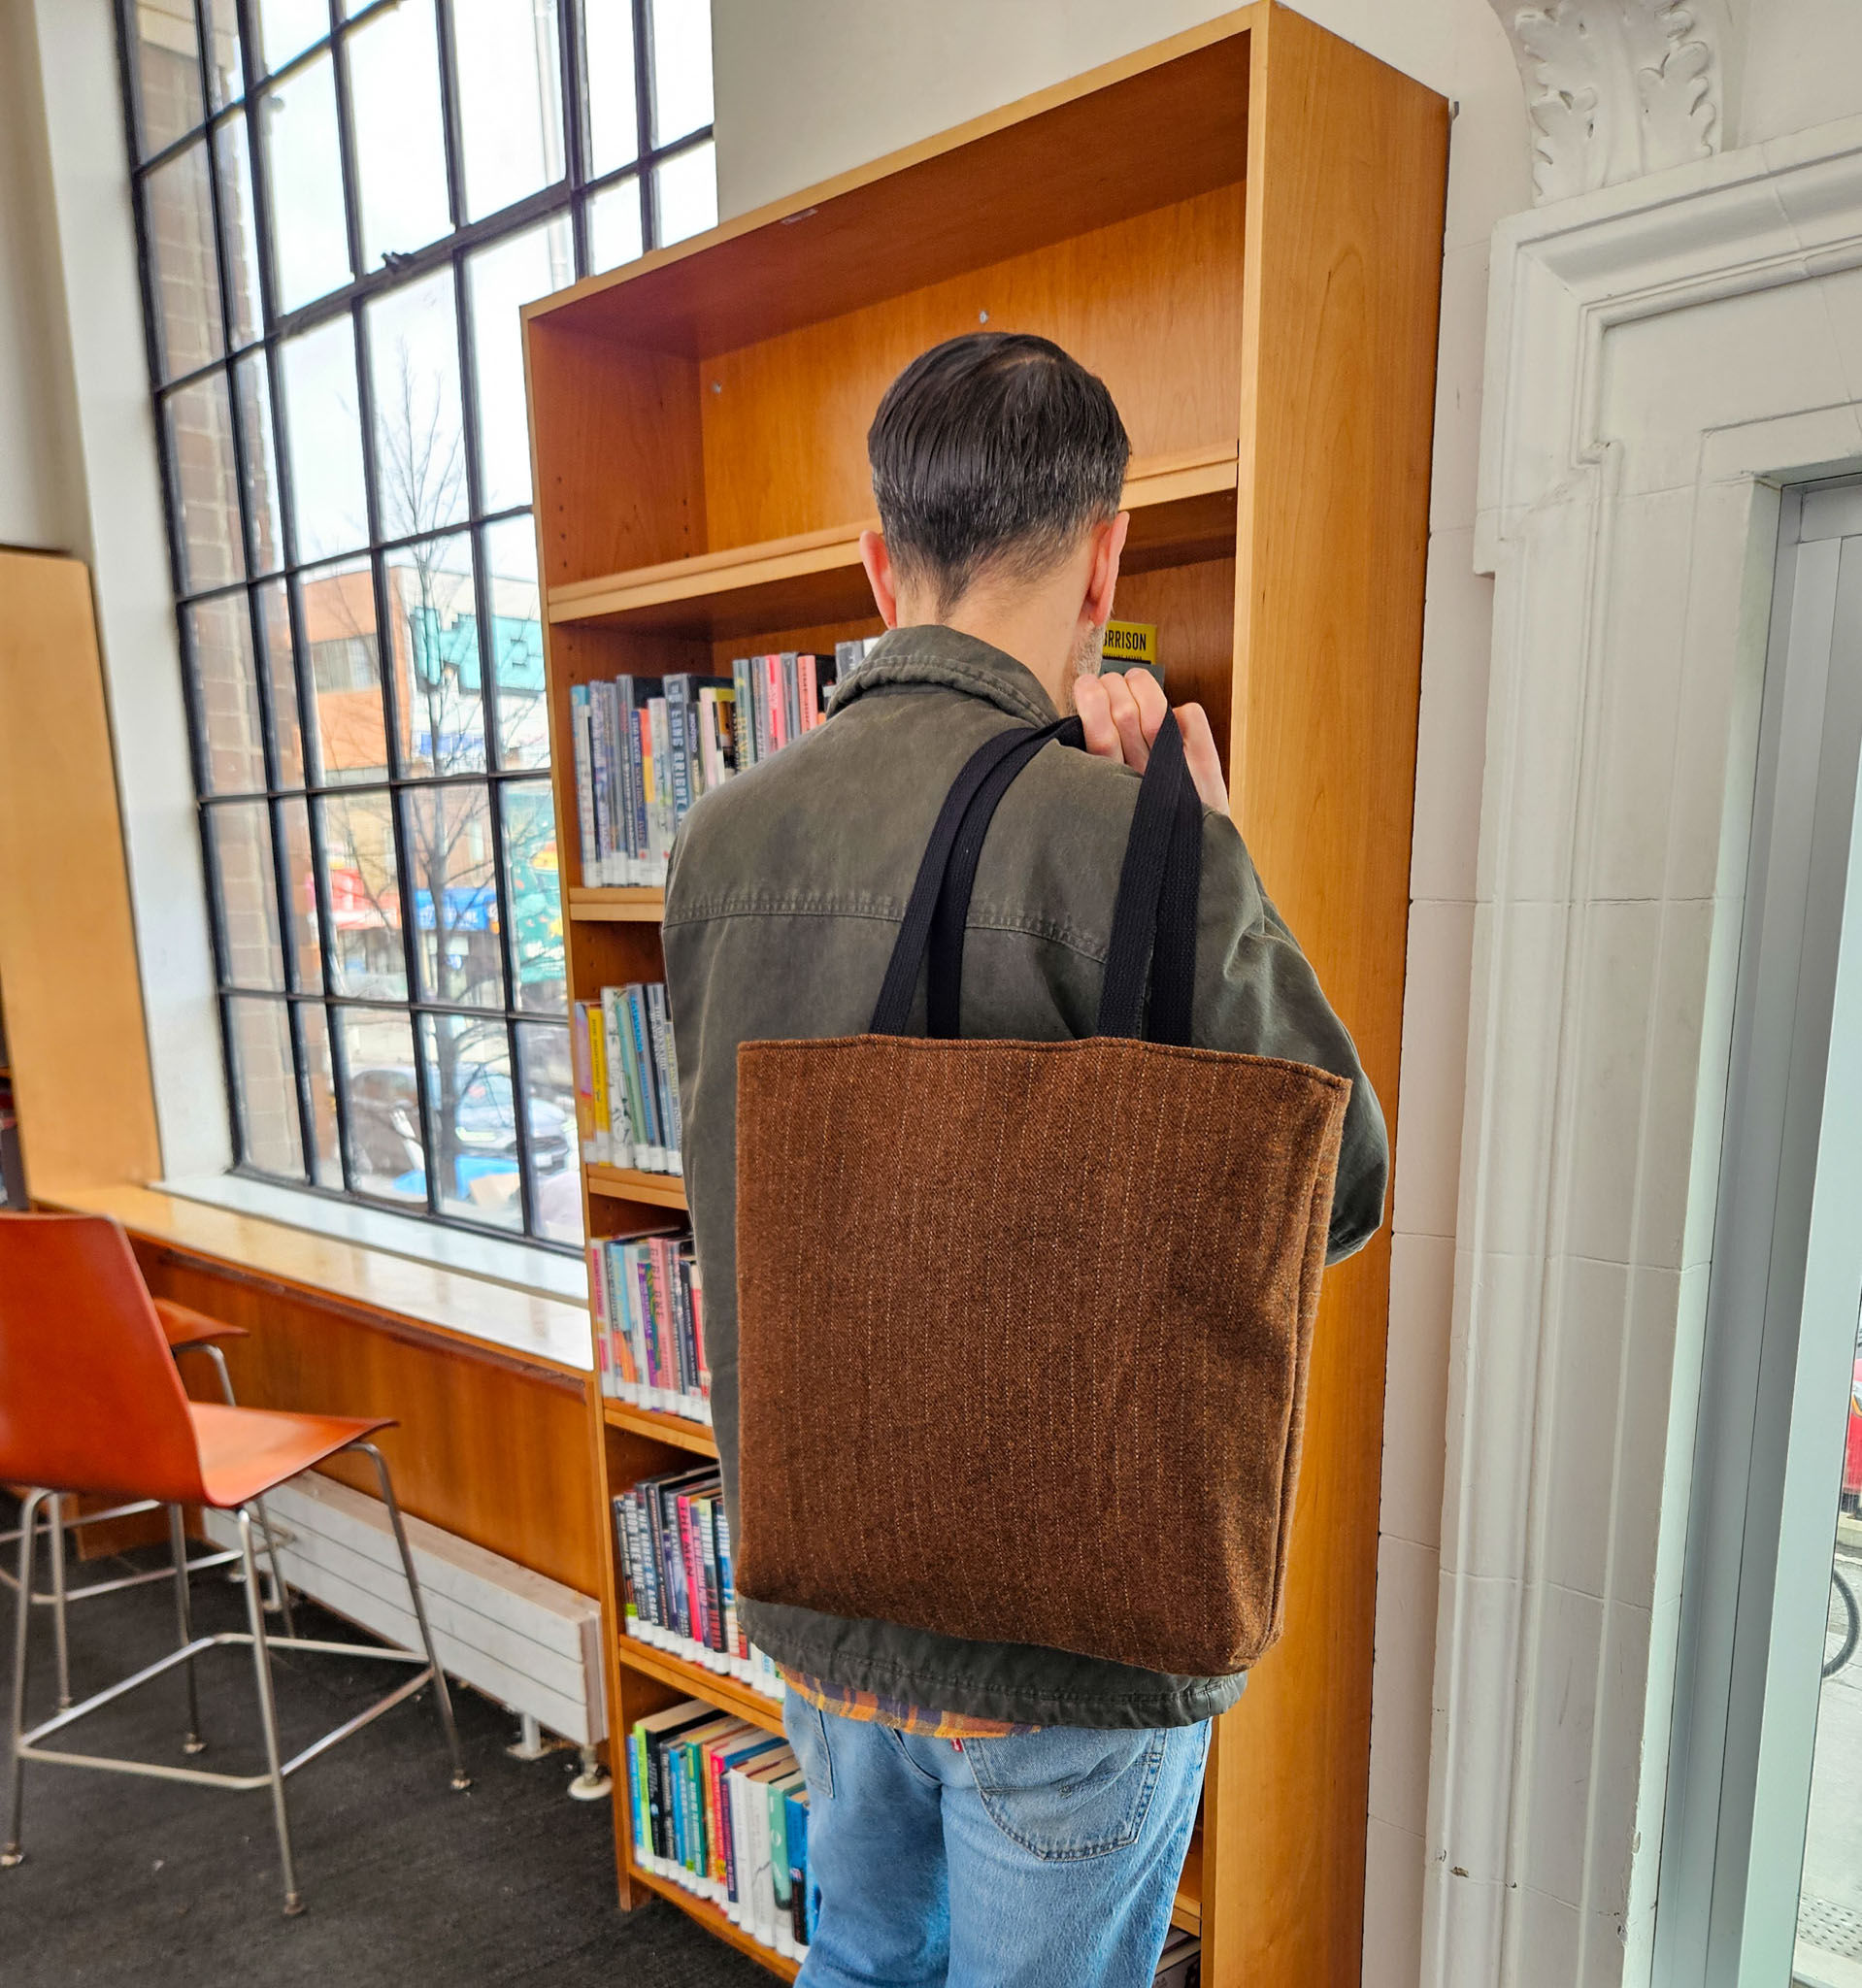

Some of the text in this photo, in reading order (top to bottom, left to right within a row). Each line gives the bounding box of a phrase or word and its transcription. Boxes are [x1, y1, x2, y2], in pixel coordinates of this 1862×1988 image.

[673, 751, 687, 812] BRIGHT
[638, 1508, 648, 1528] THE
[628, 1536, 642, 1560] LIKE
[641, 1532, 653, 1568] HOUSE
[680, 1506, 694, 1576] THE MEN
[632, 1562, 645, 1590] MINE
[645, 1571, 654, 1586] OF
[648, 1589, 659, 1624] ASHES
